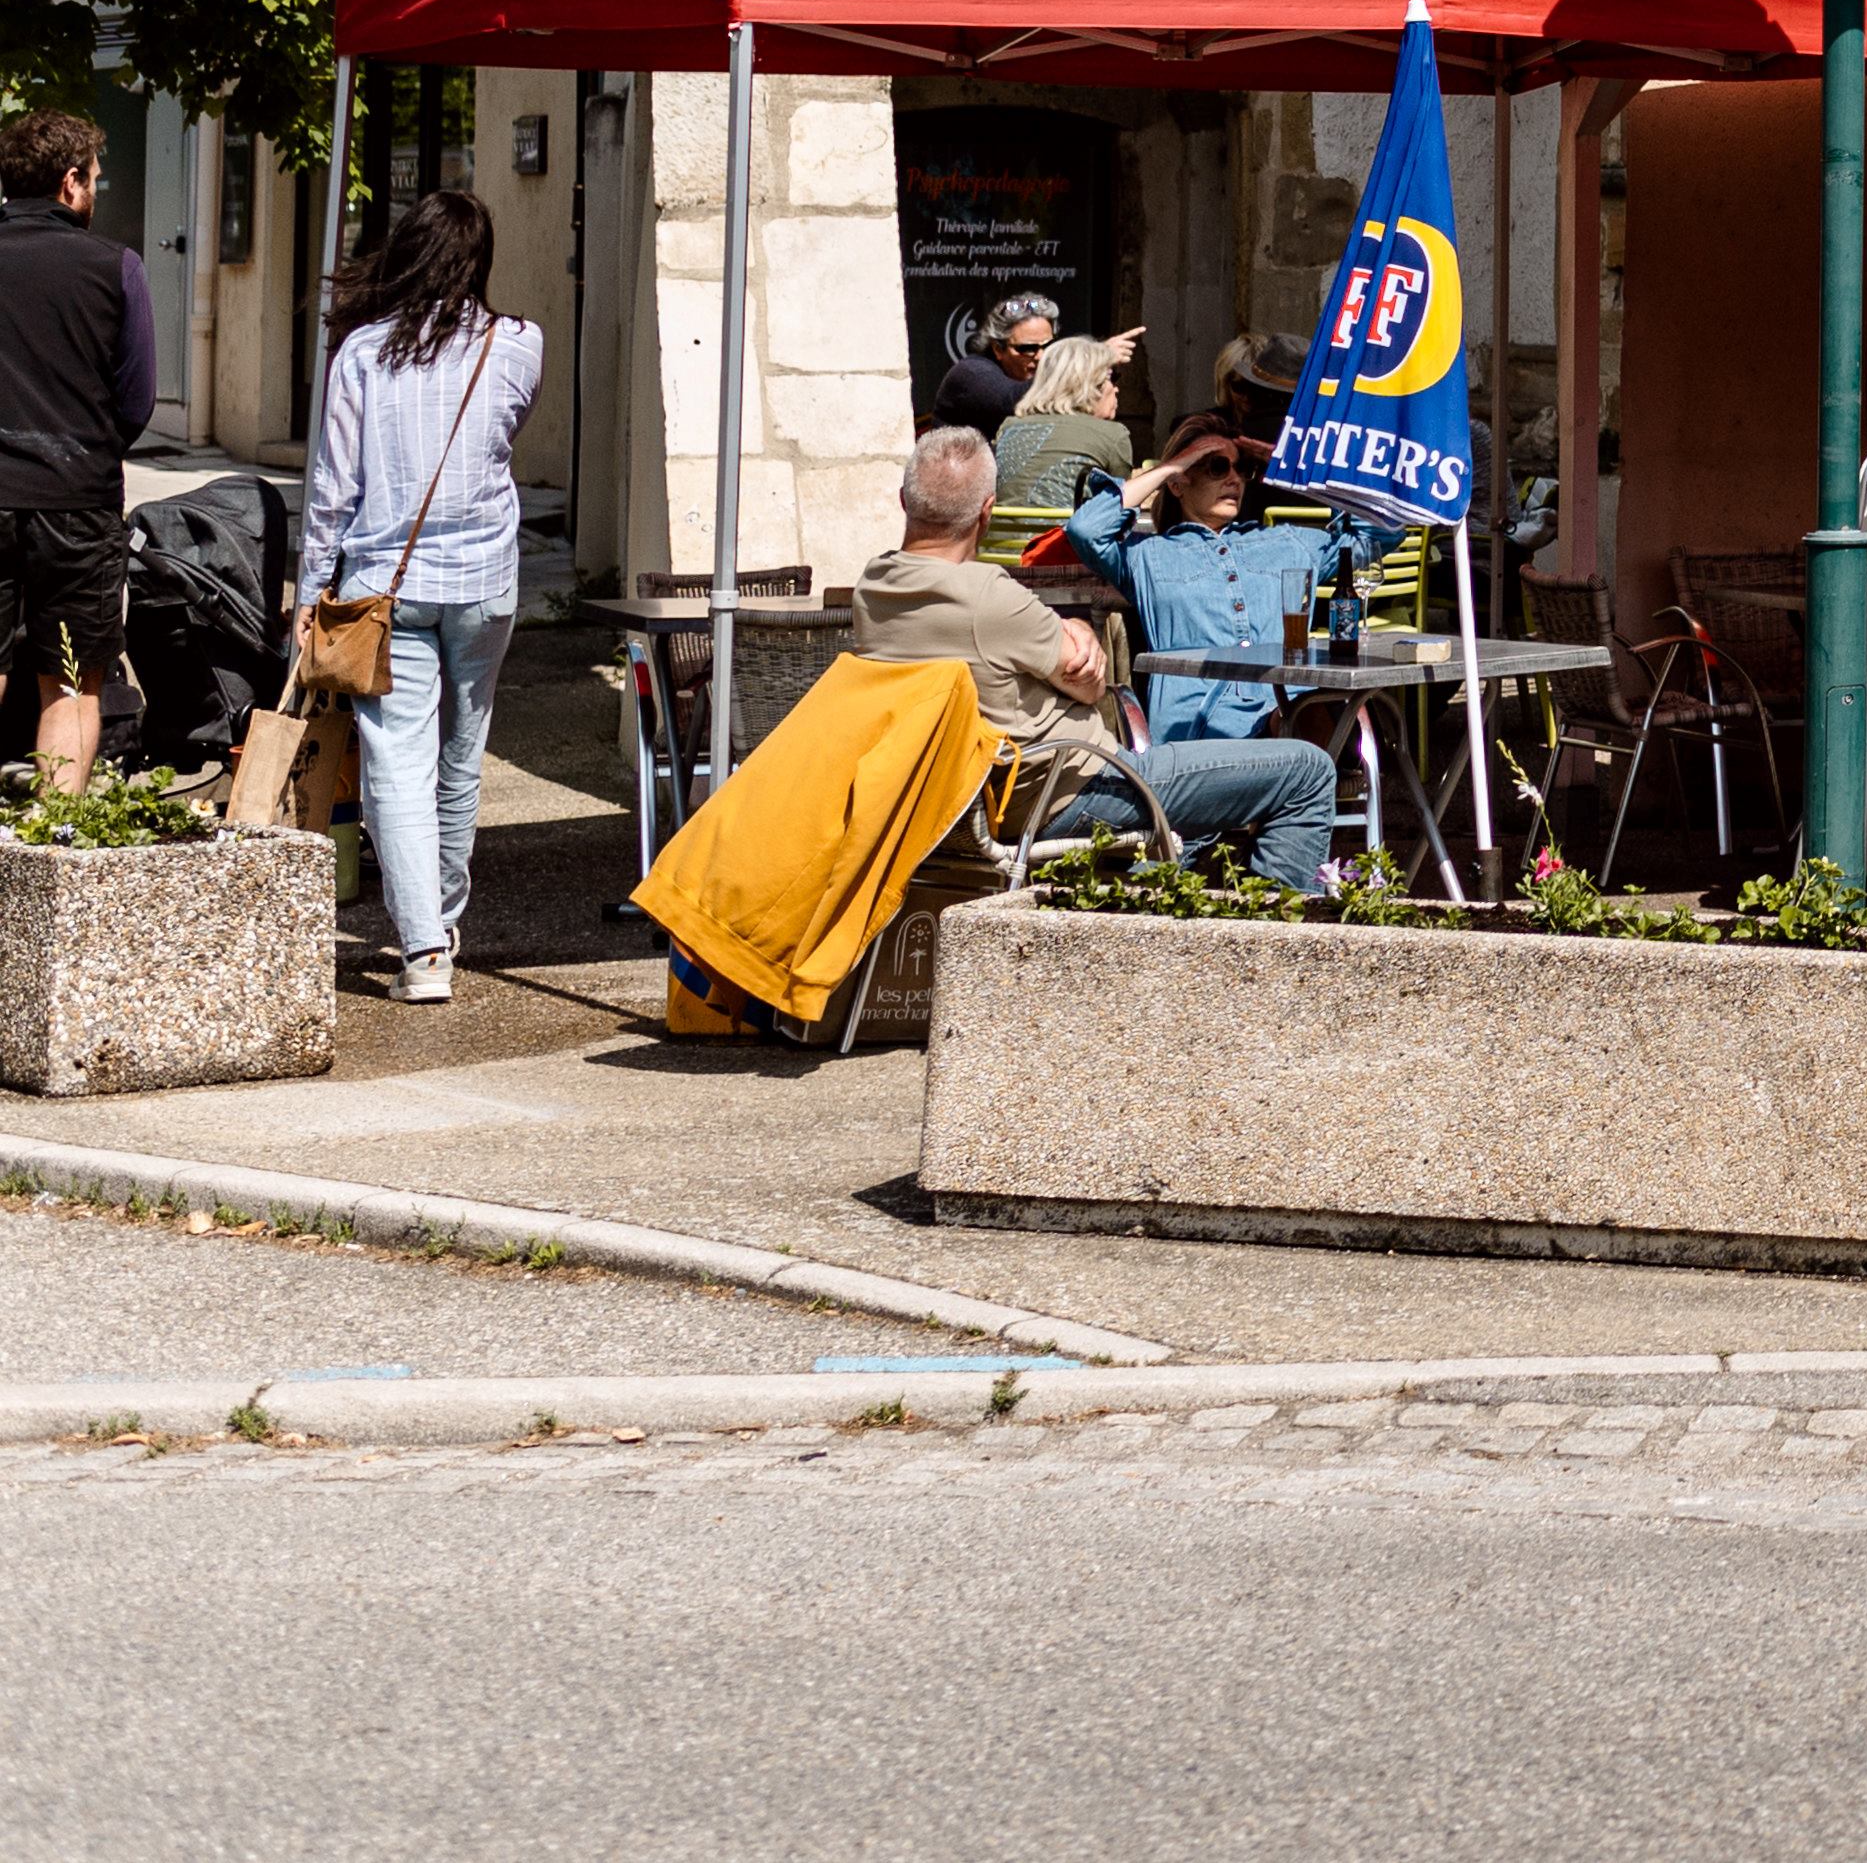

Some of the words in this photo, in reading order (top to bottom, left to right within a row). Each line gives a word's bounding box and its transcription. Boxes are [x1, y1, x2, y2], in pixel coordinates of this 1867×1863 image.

[912, 239, 967, 260] Guidance
[968, 240, 1024, 260] parentale
[1033, 239, 1061, 257] EFT
[902, 262, 968, 279] emédiation
[969, 262, 990, 278] des
[876, 986, 901, 1003] les
